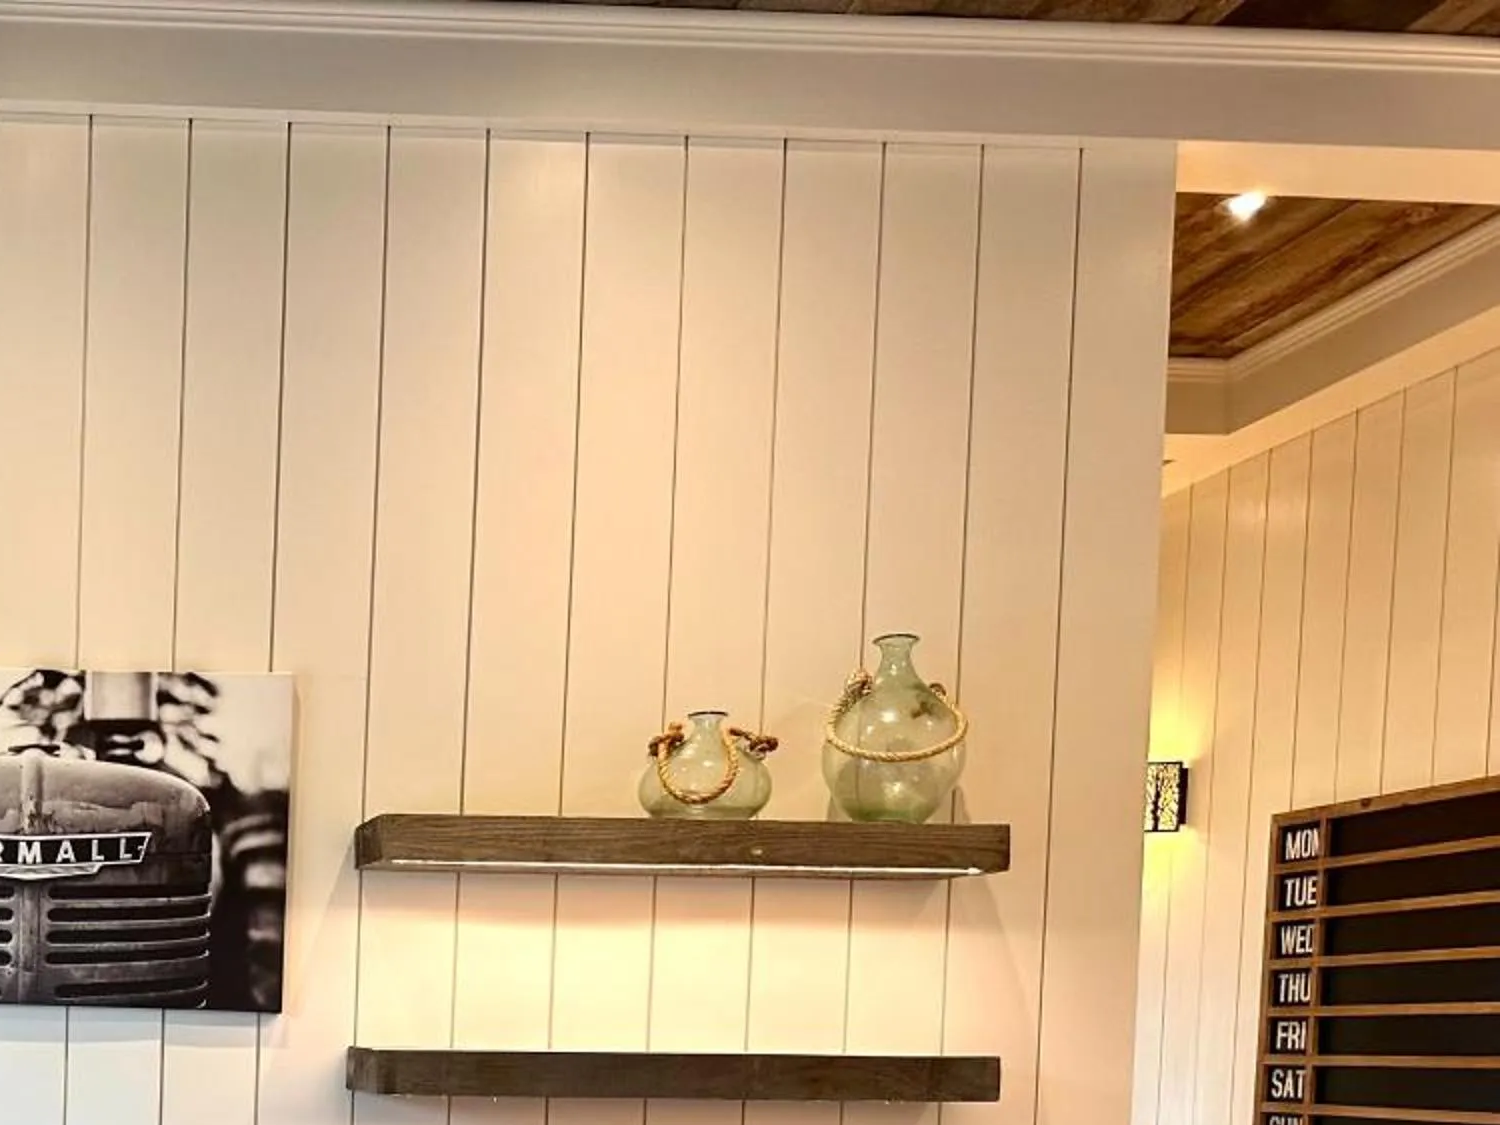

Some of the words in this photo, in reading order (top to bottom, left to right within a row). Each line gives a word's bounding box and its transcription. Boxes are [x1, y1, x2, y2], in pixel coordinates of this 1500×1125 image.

[1285, 828, 1319, 860] MON
[1284, 876, 1318, 907] TUE
[1278, 973, 1311, 1003] THU
[1276, 1021, 1306, 1050] FRI
[1271, 1069, 1306, 1099] SAT
